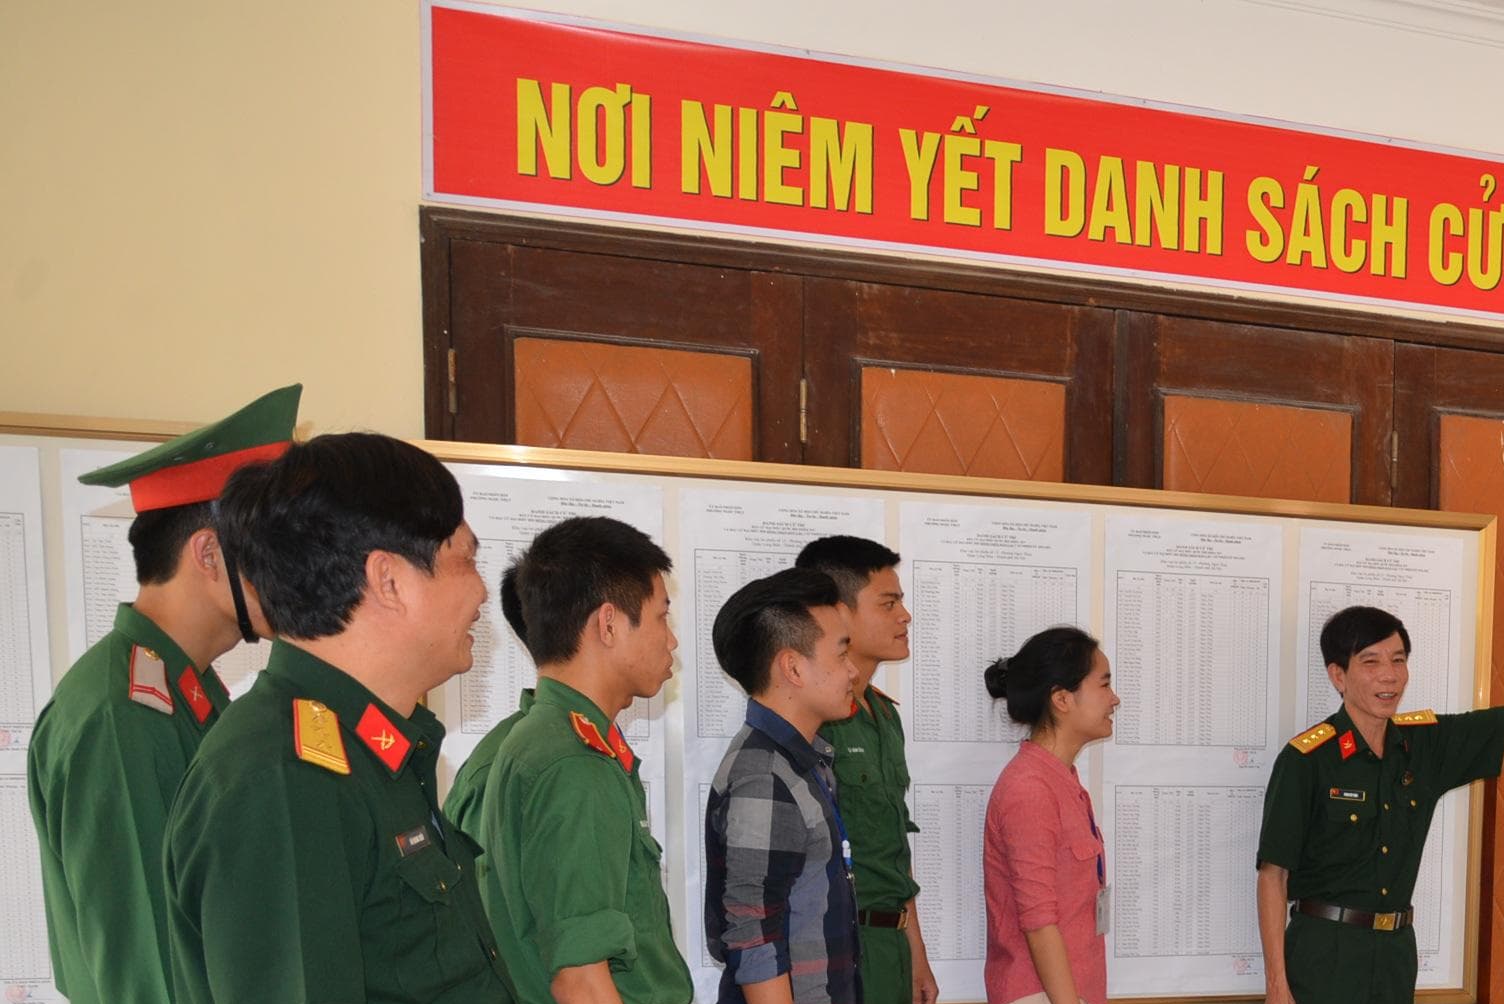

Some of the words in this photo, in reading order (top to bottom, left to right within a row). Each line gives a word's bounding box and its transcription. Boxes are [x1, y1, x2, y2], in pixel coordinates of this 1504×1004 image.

[516, 78, 652, 190] NƠI
[681, 91, 874, 215] NIÊM
[898, 105, 1022, 230] YẾT
[1044, 147, 1224, 256] DANH
[1245, 165, 1408, 279] SÁCH
